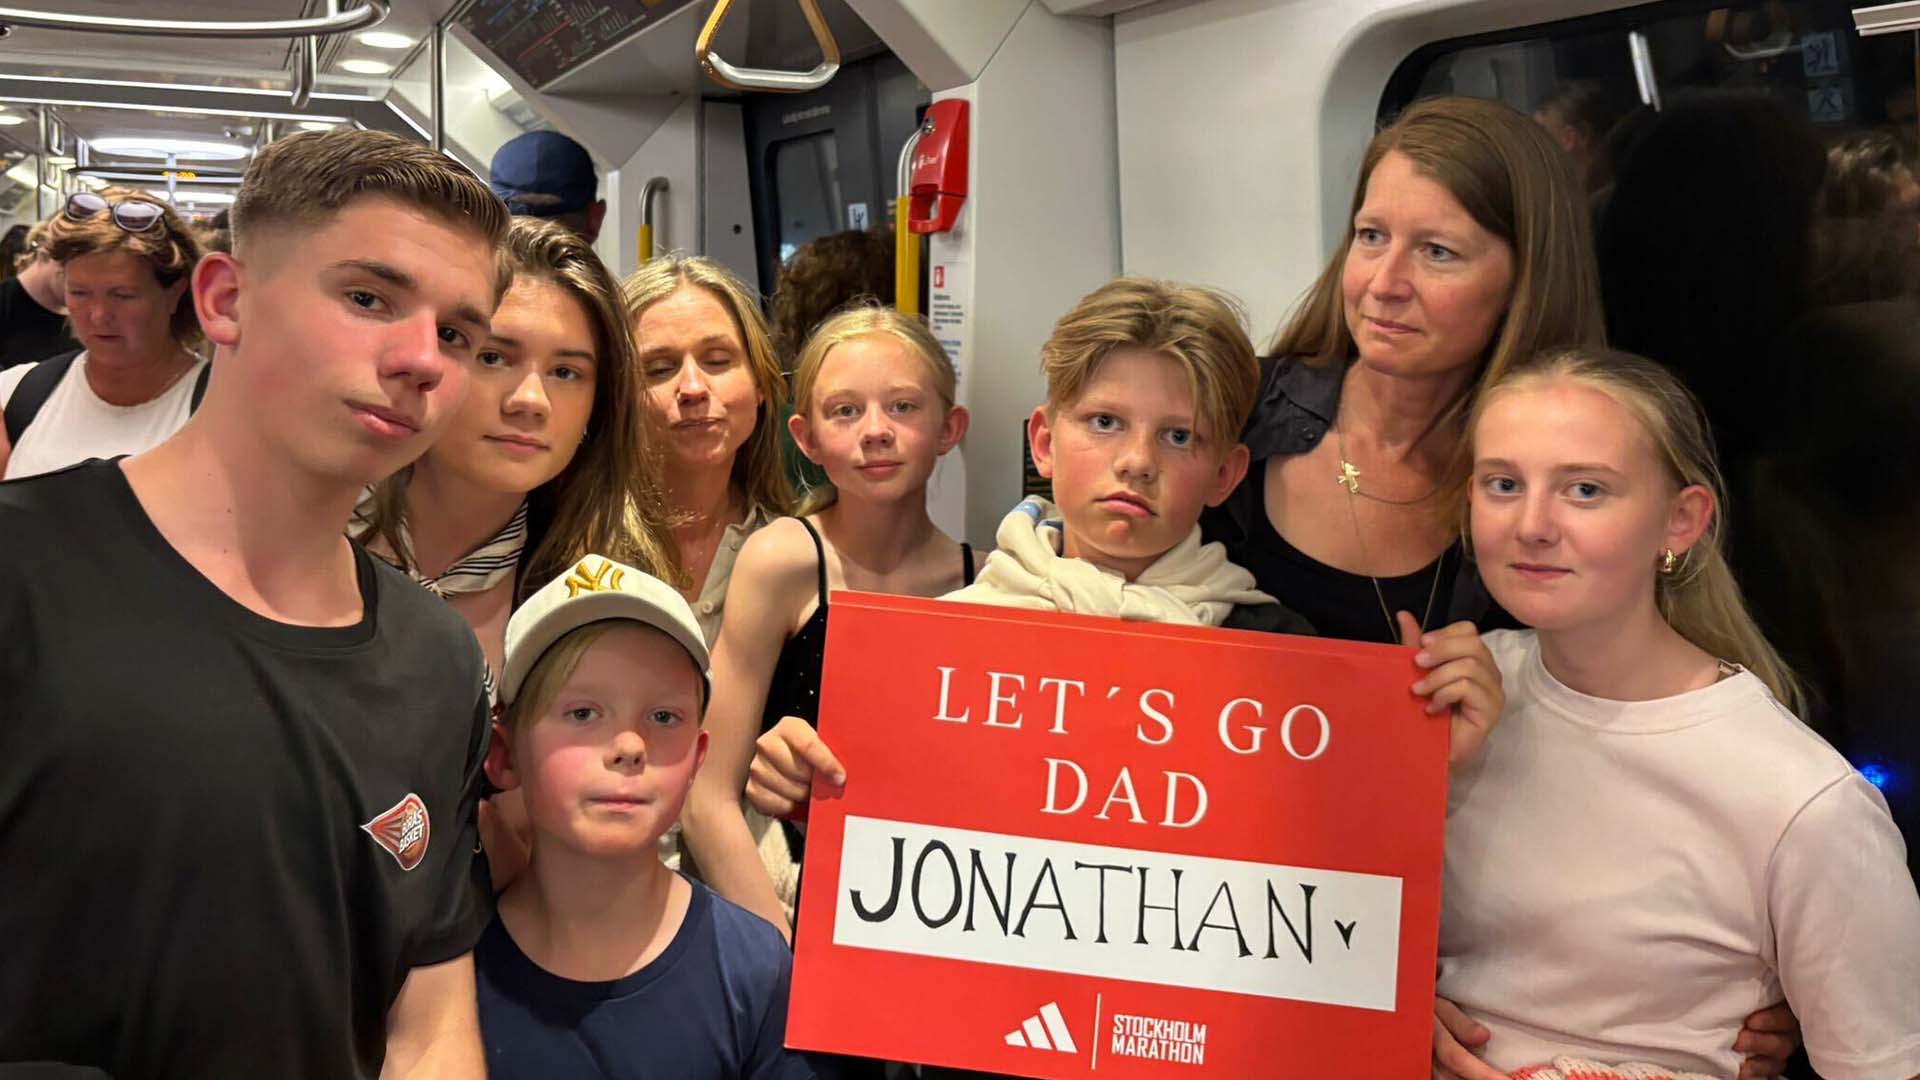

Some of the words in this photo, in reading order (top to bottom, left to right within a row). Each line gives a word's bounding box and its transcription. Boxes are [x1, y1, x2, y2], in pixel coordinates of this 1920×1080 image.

[1218, 698, 1330, 760] GO
[1040, 758, 1209, 829] DAD
[399, 822, 425, 854] BASKET
[850, 837, 1317, 964] JONATHAN
[1111, 1033, 1205, 1065] MARATHON
[1113, 1014, 1207, 1045] STOCKHOLM
